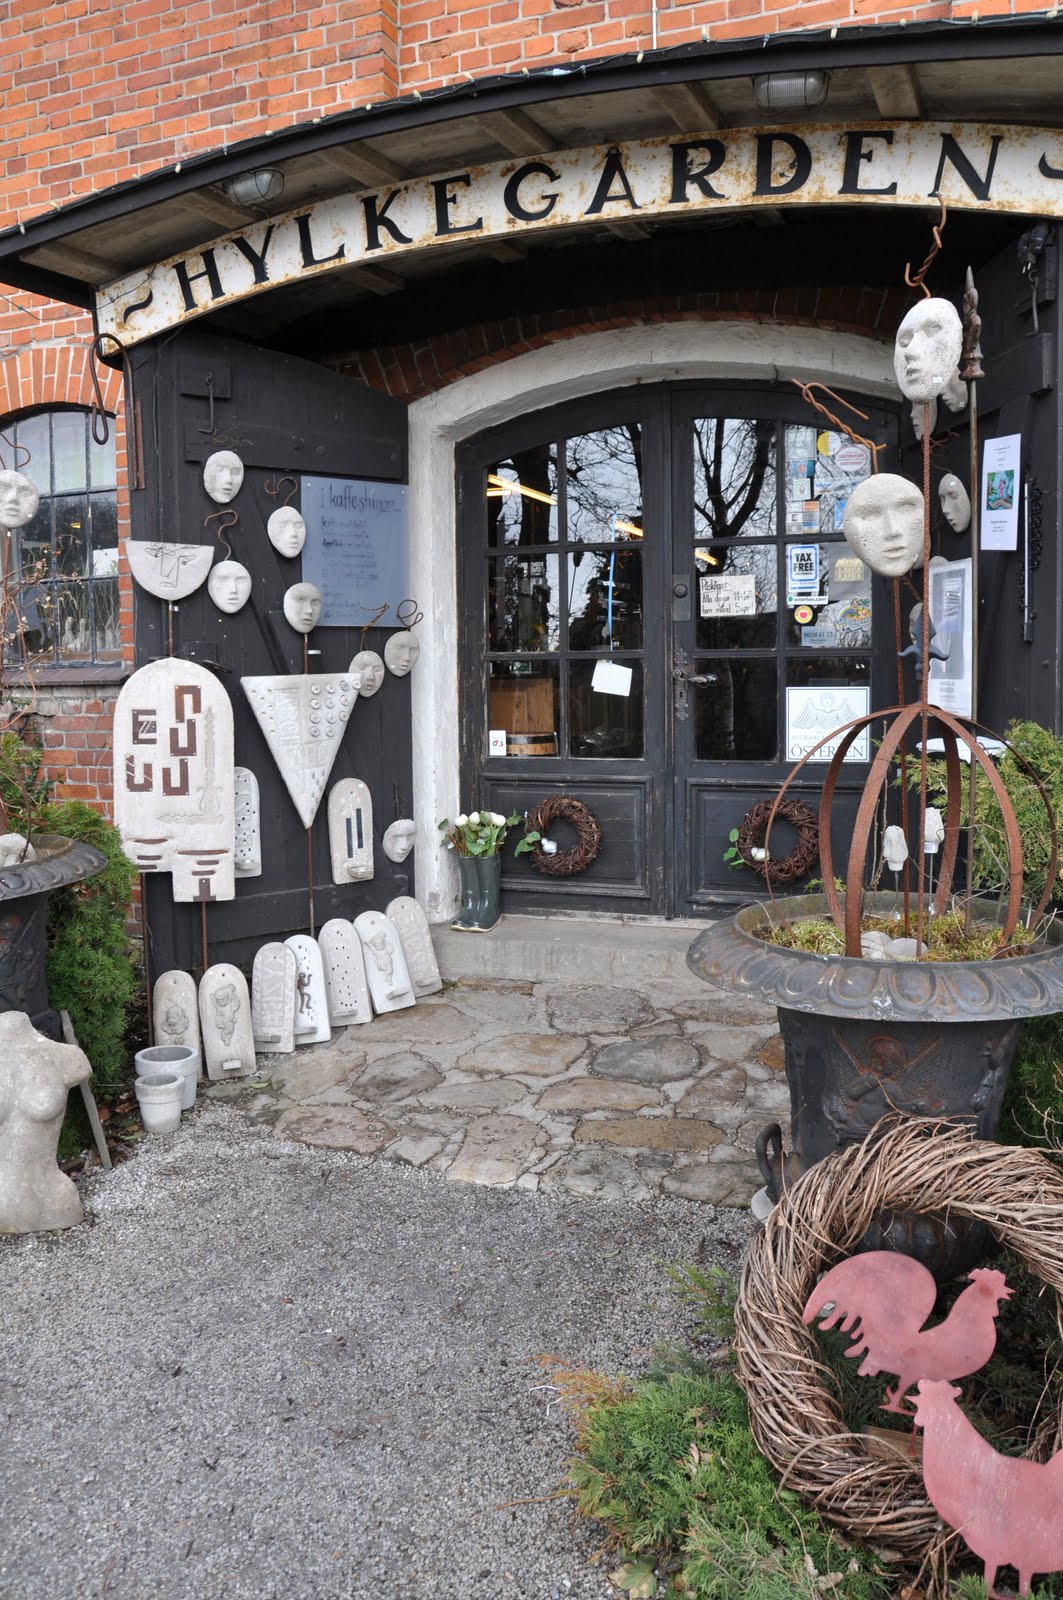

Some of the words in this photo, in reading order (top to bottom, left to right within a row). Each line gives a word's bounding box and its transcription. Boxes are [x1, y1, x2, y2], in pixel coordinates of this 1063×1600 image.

[172, 129, 1003, 314] HYLKEGÅRDEN
[795, 553, 812, 562] TAX
[793, 562, 814, 572] FREE
